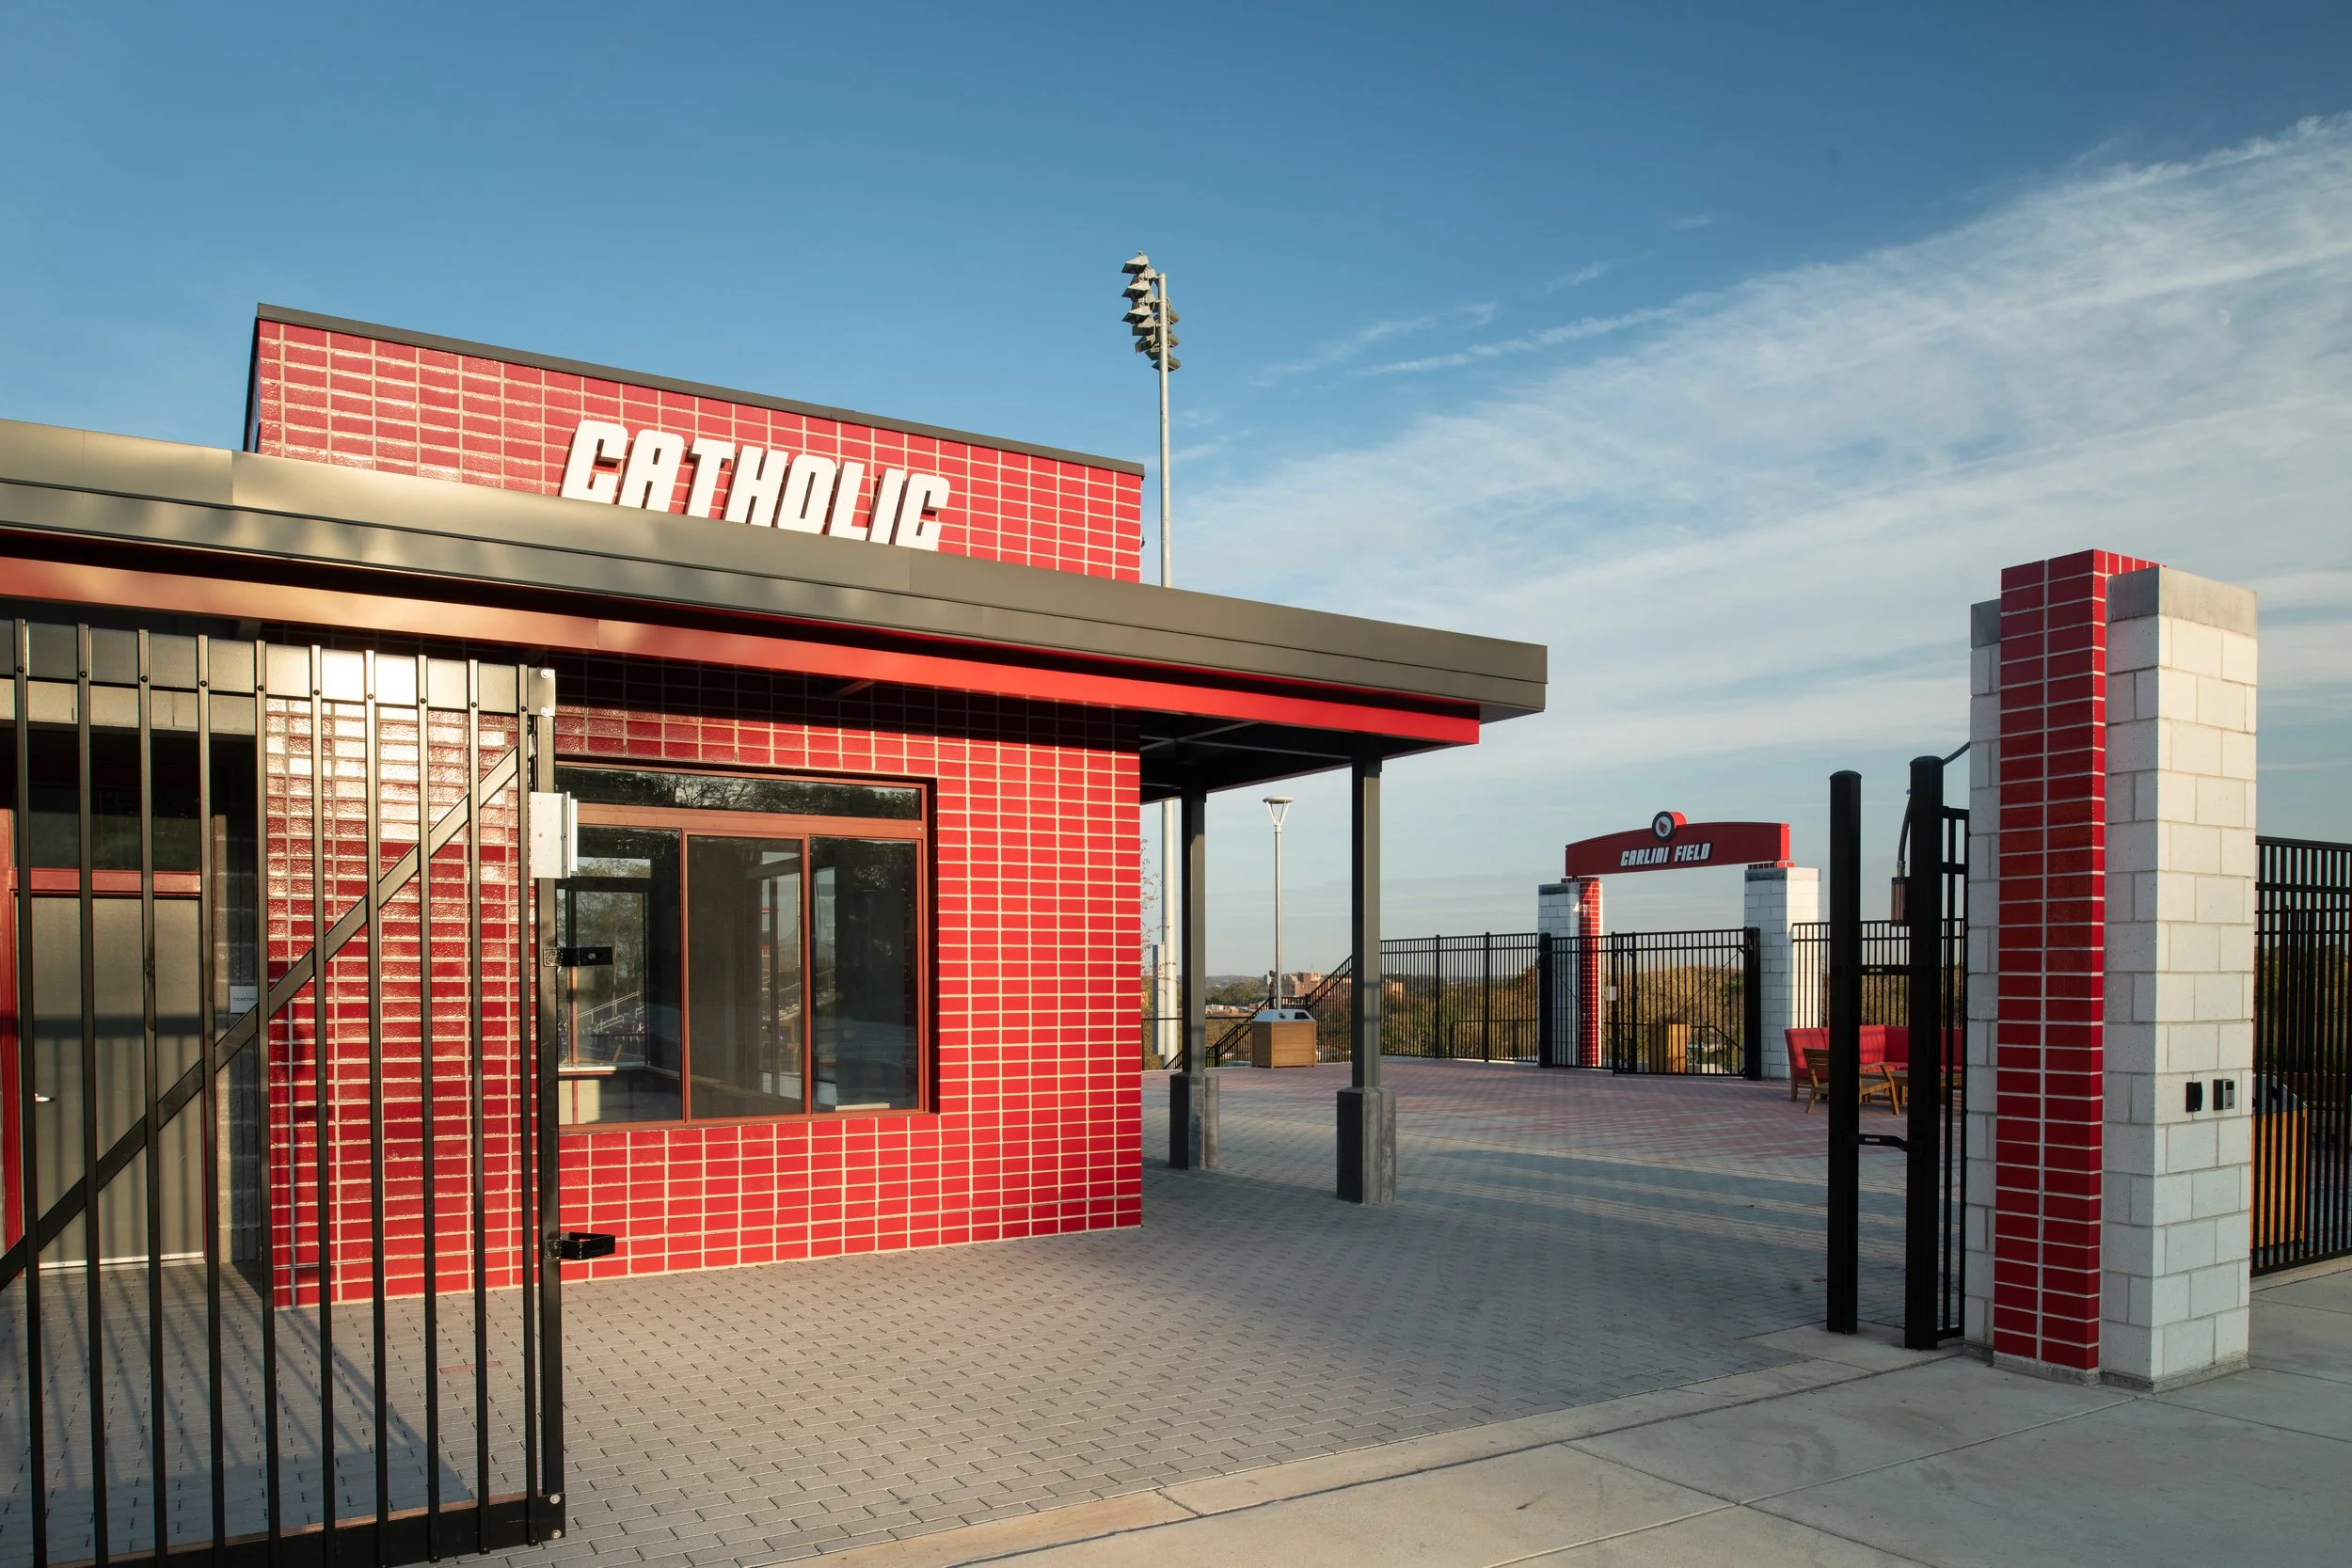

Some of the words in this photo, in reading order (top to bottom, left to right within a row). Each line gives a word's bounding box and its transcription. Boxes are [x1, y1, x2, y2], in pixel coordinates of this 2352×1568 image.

[560, 419, 951, 552] CATHOLIC
[1620, 847, 1670, 866] CARLINI
[1674, 843, 1711, 863] FIELD
